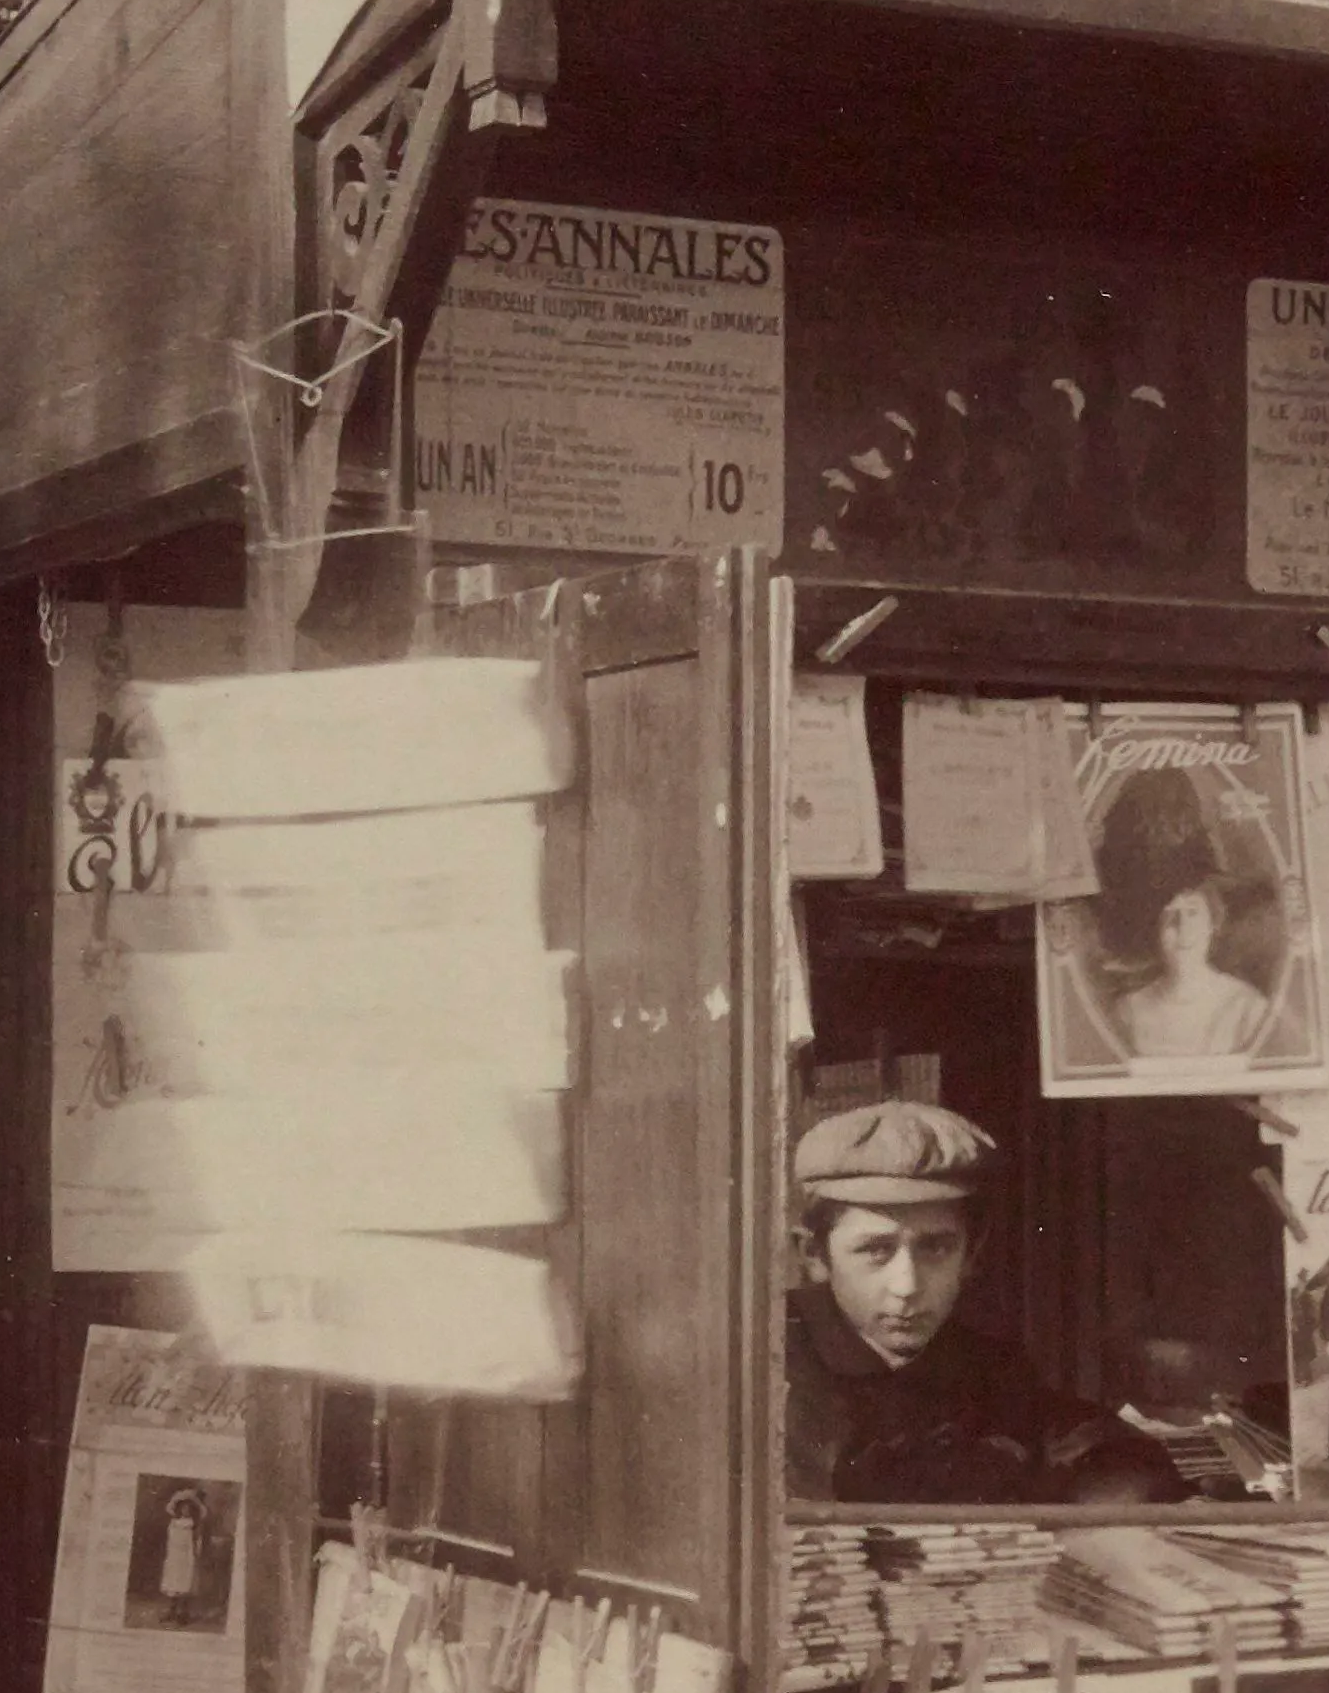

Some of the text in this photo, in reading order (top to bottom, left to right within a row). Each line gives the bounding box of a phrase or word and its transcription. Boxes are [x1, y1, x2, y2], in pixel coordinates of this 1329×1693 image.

[522, 213, 771, 286] ANNALES
[416, 439, 451, 493] UN
[461, 442, 497, 496] AN
[704, 459, 745, 515] 10
[1073, 715, 1260, 785] Femina
